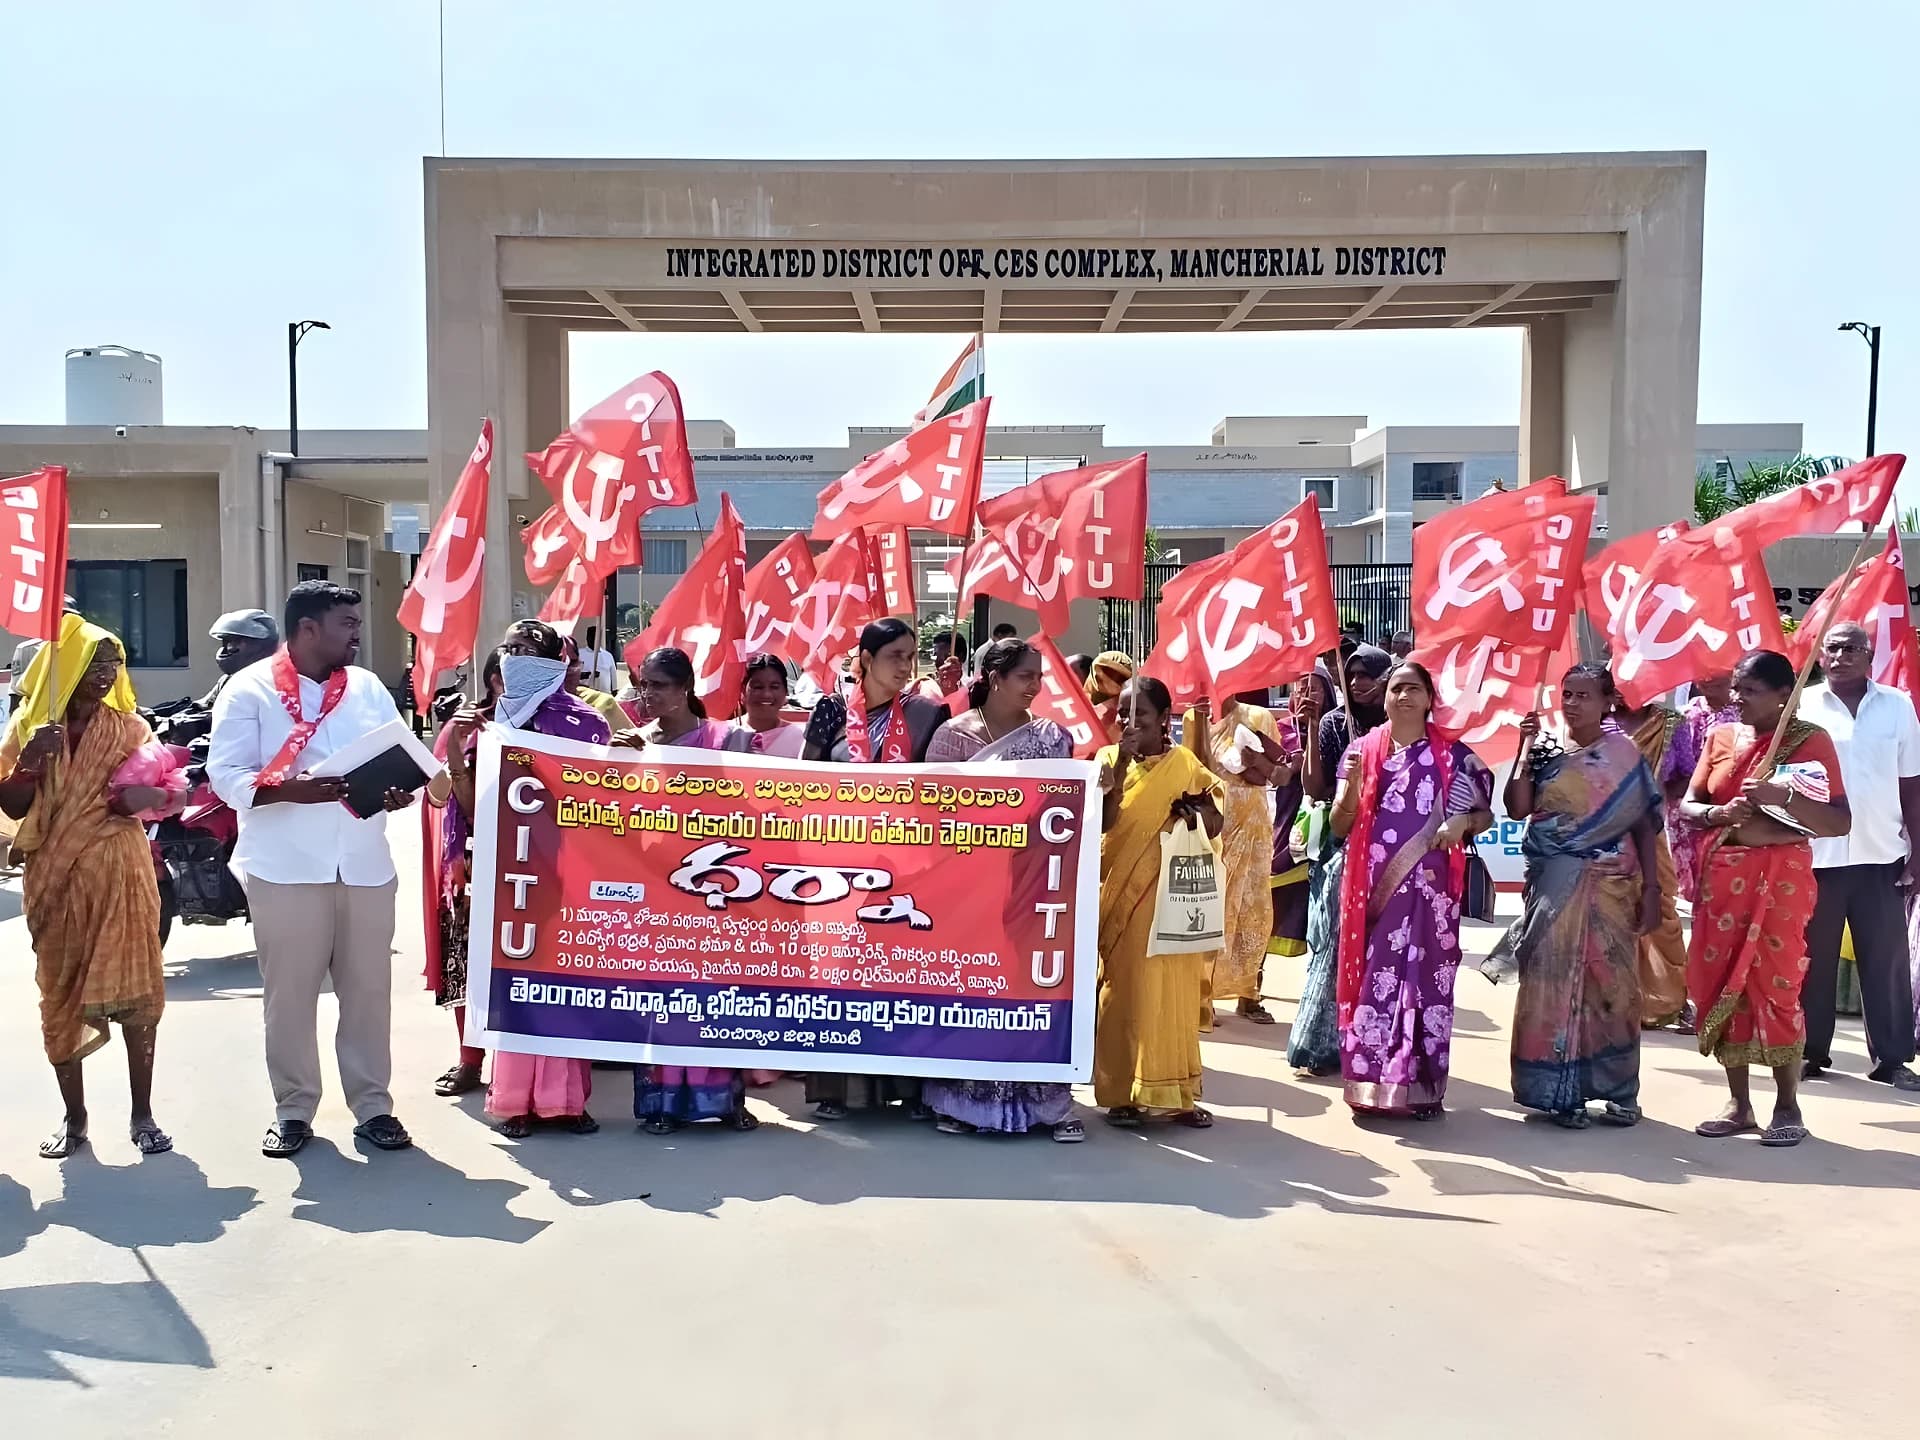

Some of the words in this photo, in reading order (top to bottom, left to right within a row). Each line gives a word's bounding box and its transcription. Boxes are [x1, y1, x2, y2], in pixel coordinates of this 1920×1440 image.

[666, 248, 816, 278] INTEGRATED
[822, 248, 933, 278] DISTRICT
[1045, 248, 1163, 282] COMPLEX,
[1169, 247, 1325, 278] MANCHERIAL
[1335, 247, 1446, 276] DISTRICT
[755, 778, 831, 807] బిల్లులు
[836, 777, 915, 805] వెంటనే
[920, 784, 1024, 812] చెల్లించాలి
[557, 796, 625, 835] ప్రభుత్వ
[629, 804, 678, 833] హామీ
[683, 809, 756, 840] ప్రకారం
[871, 811, 934, 845] వేతనం
[939, 819, 1028, 854] చెల్లించాలి
[501, 777, 545, 959] CITU
[560, 907, 574, 922] 1)
[1031, 807, 1075, 987] CITU
[558, 930, 573, 945] 2)
[779, 942, 797, 956] 10
[574, 954, 594, 969] 60
[809, 966, 819, 980] 2
[510, 977, 606, 1008] తెలంగాణ
[611, 987, 704, 1023] మధ్యాహ్న
[707, 986, 771, 1021] భోజన
[776, 994, 841, 1024] పథకం
[845, 999, 935, 1031] కార్మికుల
[940, 1003, 1051, 1031] యూనియన్
[700, 1025, 779, 1046] మంచిర్యాల
[783, 1030, 815, 1048] జిల్లా
